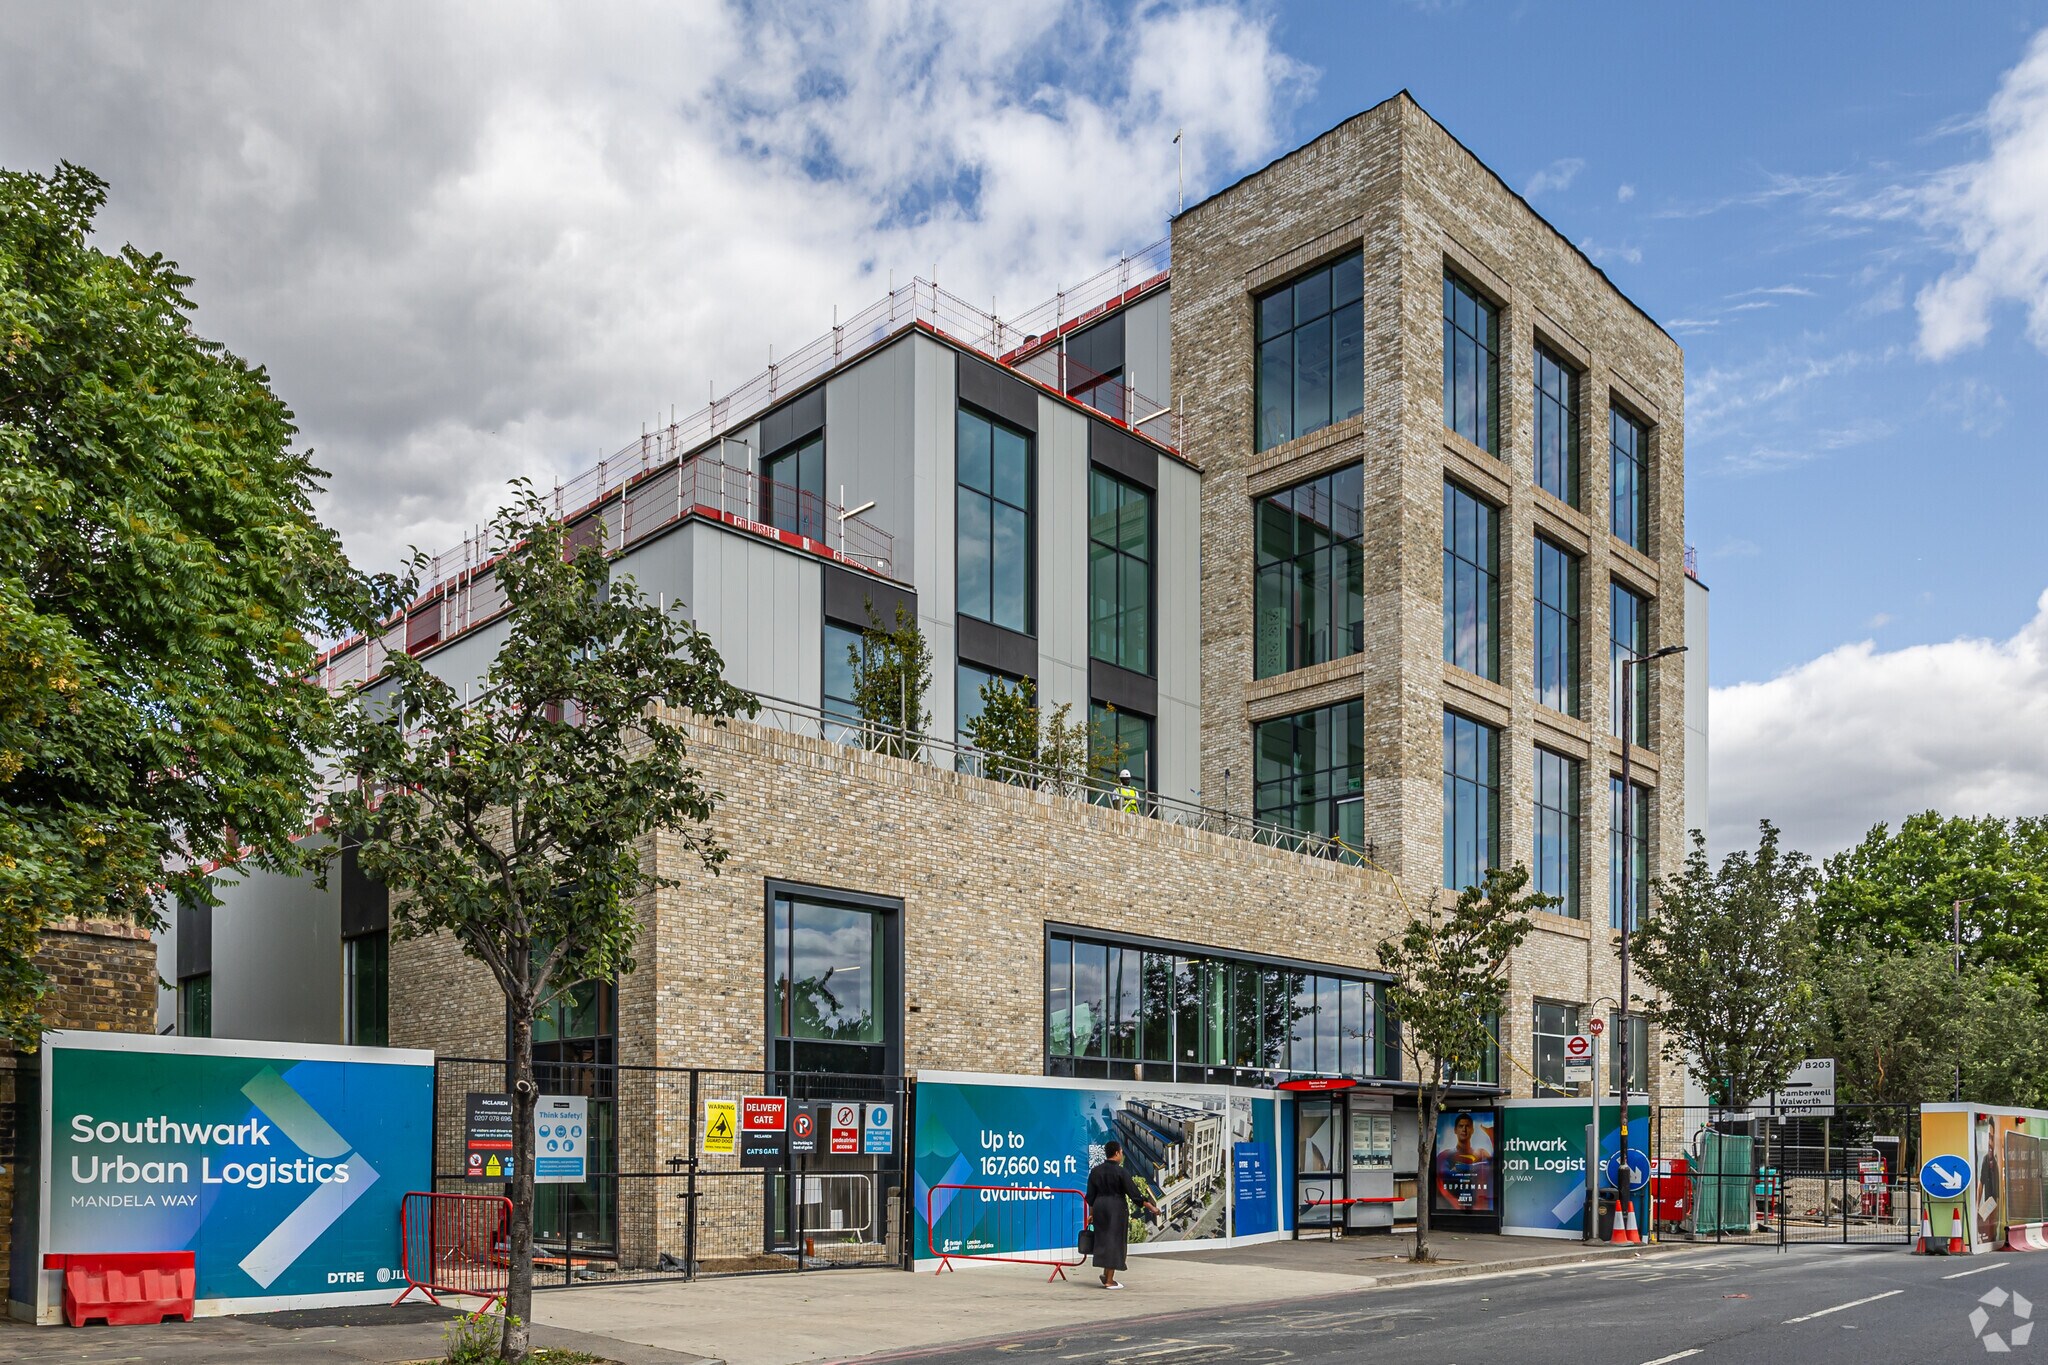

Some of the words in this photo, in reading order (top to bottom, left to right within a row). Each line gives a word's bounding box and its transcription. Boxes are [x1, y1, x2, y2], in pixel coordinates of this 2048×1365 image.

[70, 1114, 270, 1146] Southwark
[981, 1130, 1004, 1152] Up
[1008, 1131, 1024, 1148] to
[71, 1155, 188, 1184] Urban
[202, 1156, 350, 1189] Logistics
[980, 1156, 1039, 1178] 167,660
[1043, 1160, 1060, 1177] sq
[1064, 1155, 1077, 1173] ft
[71, 1195, 156, 1208] MANDELA
[160, 1194, 197, 1207] WAY
[980, 1182, 1054, 1202] available.
[327, 1271, 364, 1284] DTRE
